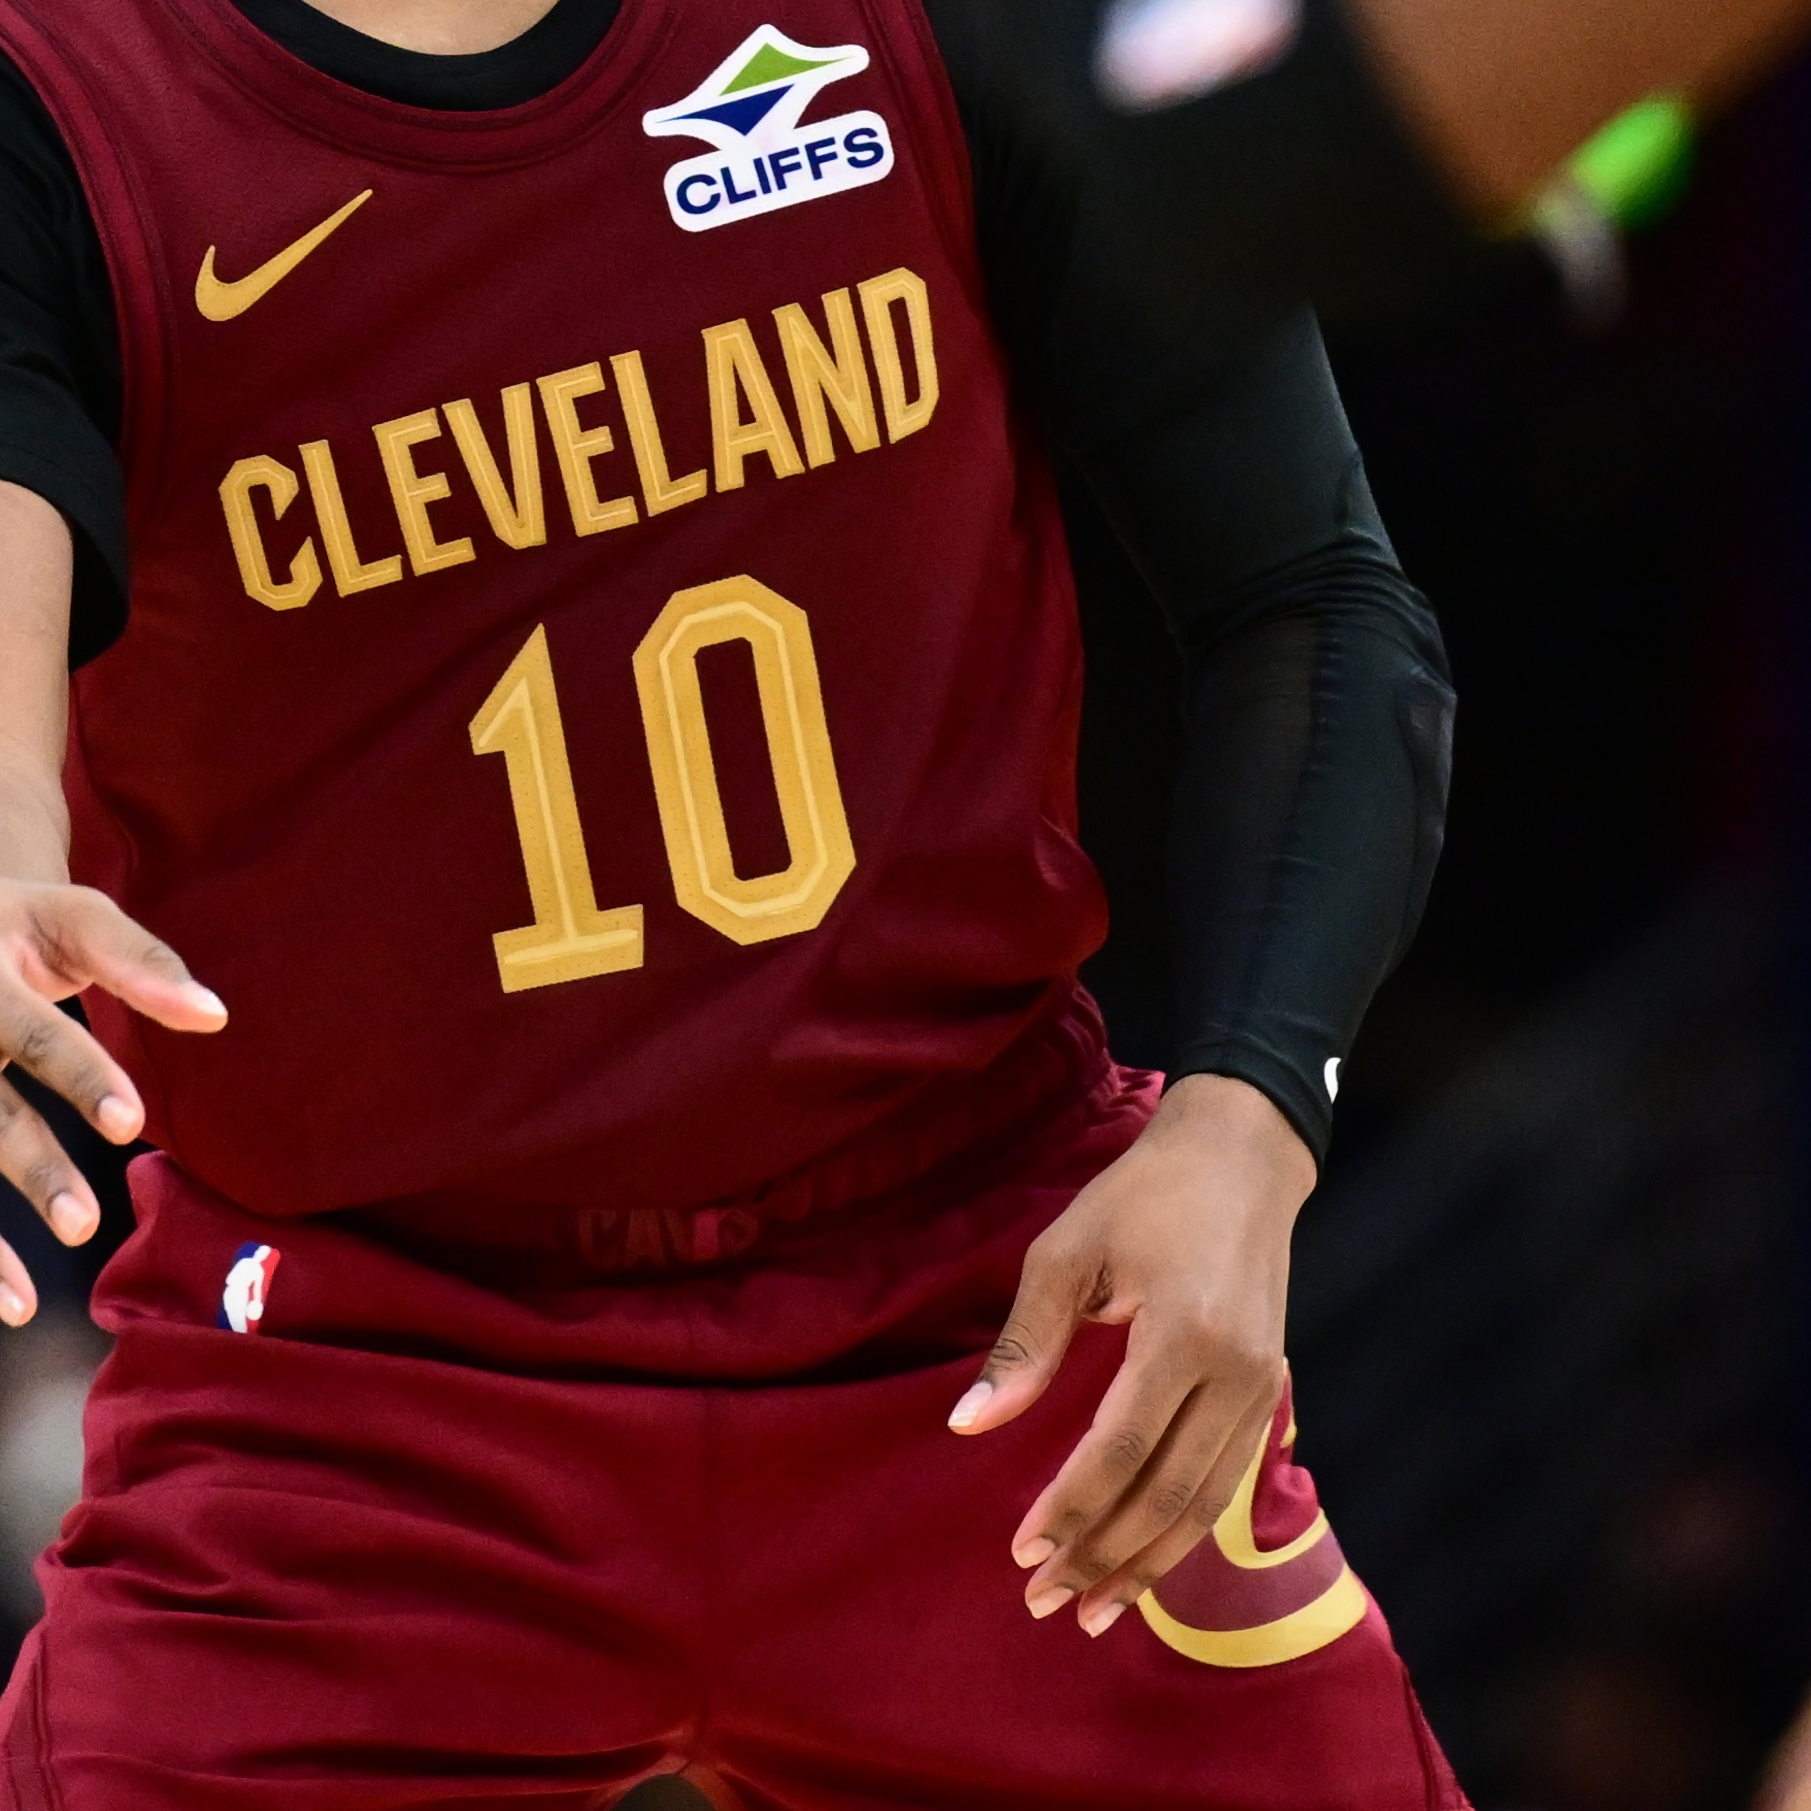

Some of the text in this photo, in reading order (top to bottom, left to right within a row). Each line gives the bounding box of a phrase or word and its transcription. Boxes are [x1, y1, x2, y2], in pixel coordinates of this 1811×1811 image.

[675, 127, 885, 215] CLIFFS
[218, 266, 940, 612] CLEVELAND
[468, 573, 856, 994] 10
